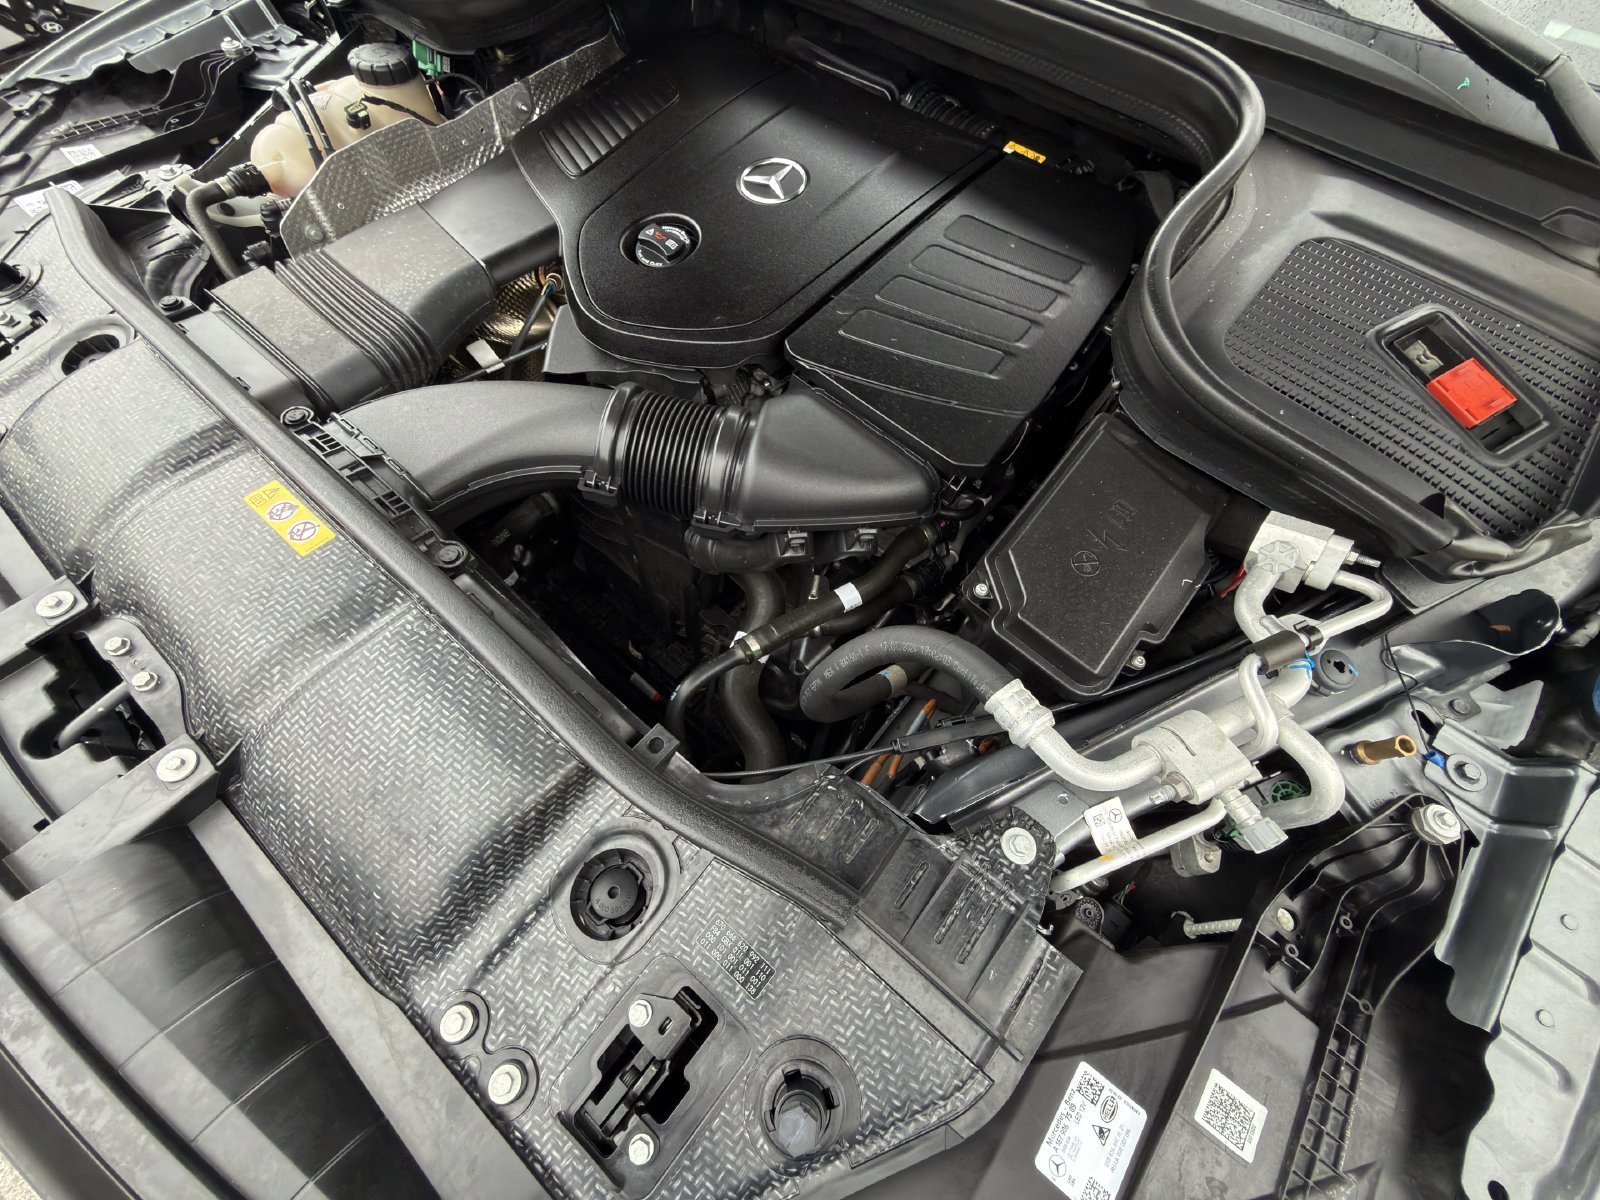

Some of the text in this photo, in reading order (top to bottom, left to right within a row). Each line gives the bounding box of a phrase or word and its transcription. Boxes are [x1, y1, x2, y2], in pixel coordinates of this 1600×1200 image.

[700, 938, 711, 950] 011
[711, 949, 722, 961] 000
[722, 960, 734, 972] 011
[733, 970, 745, 983] 000
[705, 931, 761, 988] 000 101 001 011 001
[715, 919, 726, 931] 670
[737, 940, 749, 952] 620
[749, 951, 760, 964] 992
[760, 963, 771, 975] 111
[733, 946, 743, 959] 011
[743, 957, 755, 970] 001
[755, 969, 767, 981] 110
[1046, 1111, 1066, 1147] Mercedes
[1064, 1088, 1076, 1106] Benz
[1065, 1111, 1073, 1121] 75
[1074, 1111, 1082, 1125] LED
[1103, 1095, 1116, 1120] HELLA
